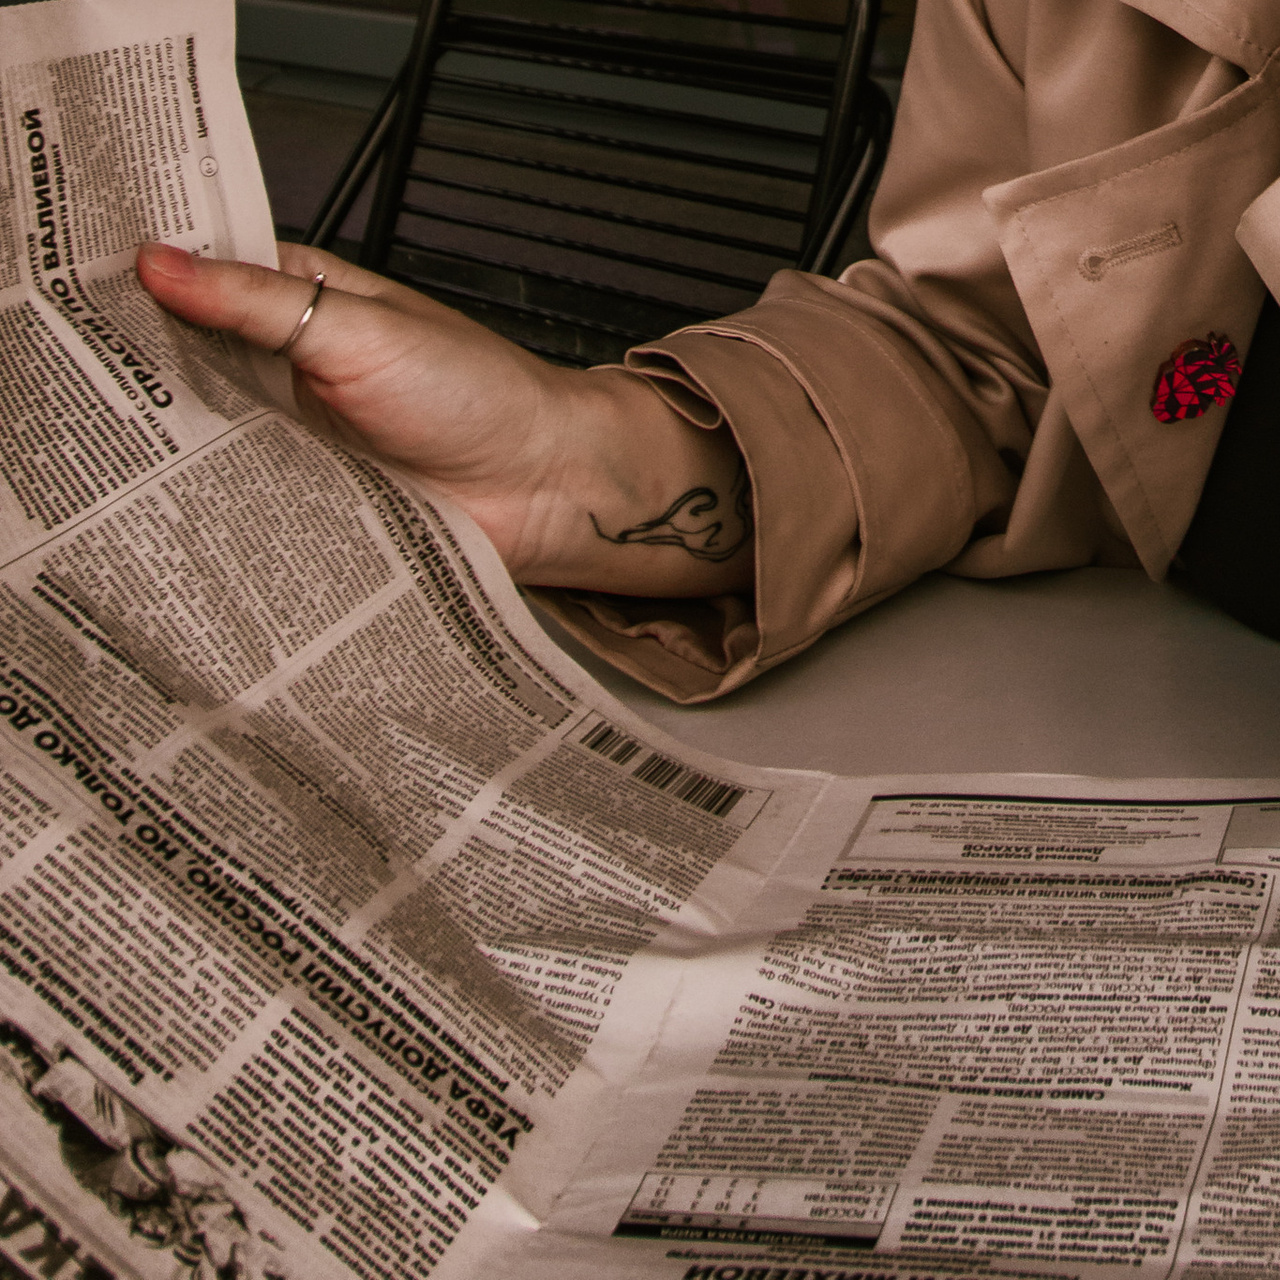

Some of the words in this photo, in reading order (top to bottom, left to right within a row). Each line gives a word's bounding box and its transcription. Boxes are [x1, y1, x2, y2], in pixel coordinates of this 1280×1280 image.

[185, 36, 202, 106] свободная
[194, 105, 209, 140] Цена
[19, 107, 62, 271] ВАЛИЕВОЙ
[25, 231, 58, 305] ФРОНТОВ
[58, 203, 76, 267] вынести
[53, 303, 140, 402] ОЛИМПИЙСКИХ
[79, 316, 174, 410] СТРАСТИ
[141, 410, 181, 456] ВЕСТИ
[72, 451, 111, 499] Начиная
[414, 574, 467, 653] ЧИТАТЕЛЕЙ
[416, 549, 451, 604] номер
[417, 526, 496, 652] ПОНЕДЕЛЬНИК,
[32, 729, 137, 828] ТОЛЬКО
[185, 857, 303, 967] РОССИЮ,
[193, 893, 282, 970] СТРОКАМИ
[652, 892, 683, 914] УЕФА
[298, 961, 450, 1084] ДОПУСТИЛ
[349, 1025, 443, 1106] ИСПОЛКОМ
[444, 1100, 511, 1166] ФУТБОЛ.
[448, 1077, 521, 1151] УЕФА
